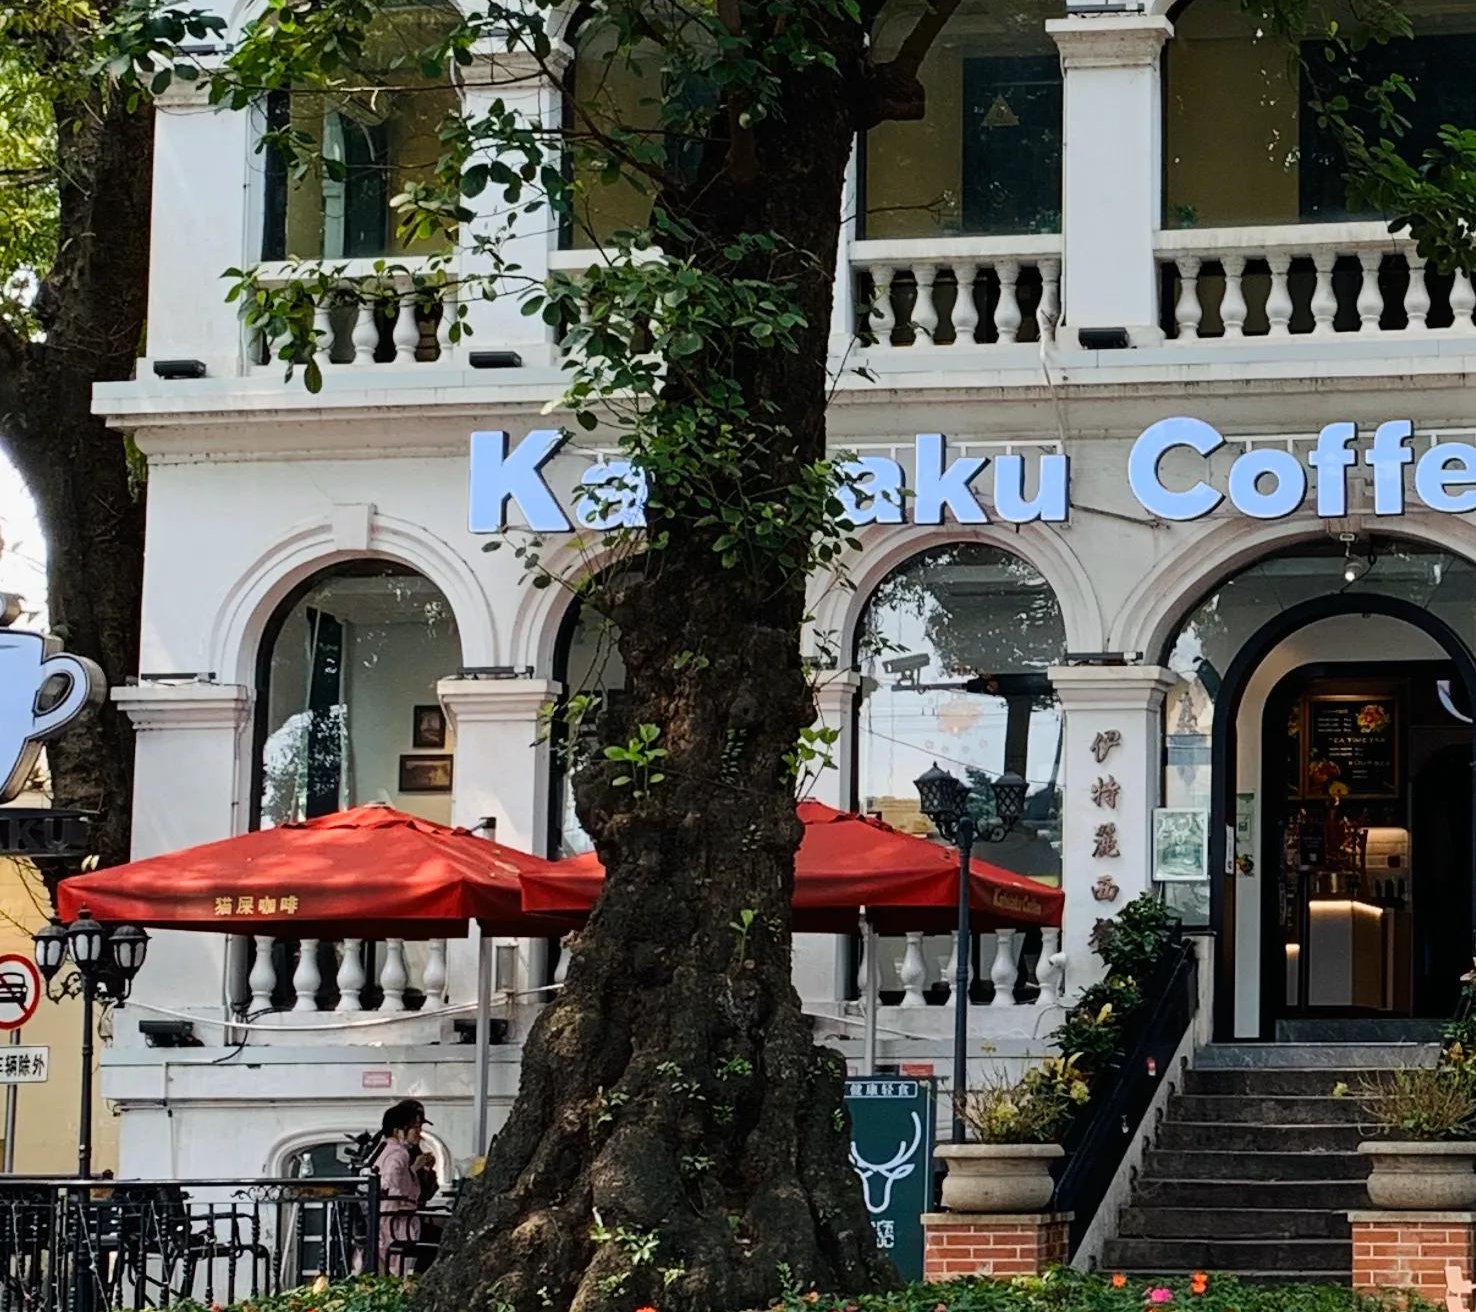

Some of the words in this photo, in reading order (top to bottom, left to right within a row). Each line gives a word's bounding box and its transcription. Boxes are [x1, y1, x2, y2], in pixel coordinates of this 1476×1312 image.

[469, 429, 1070, 533] Kaaku
[0, 817, 75, 852] KU
[214, 894, 299, 916] 猫屎咖啡
